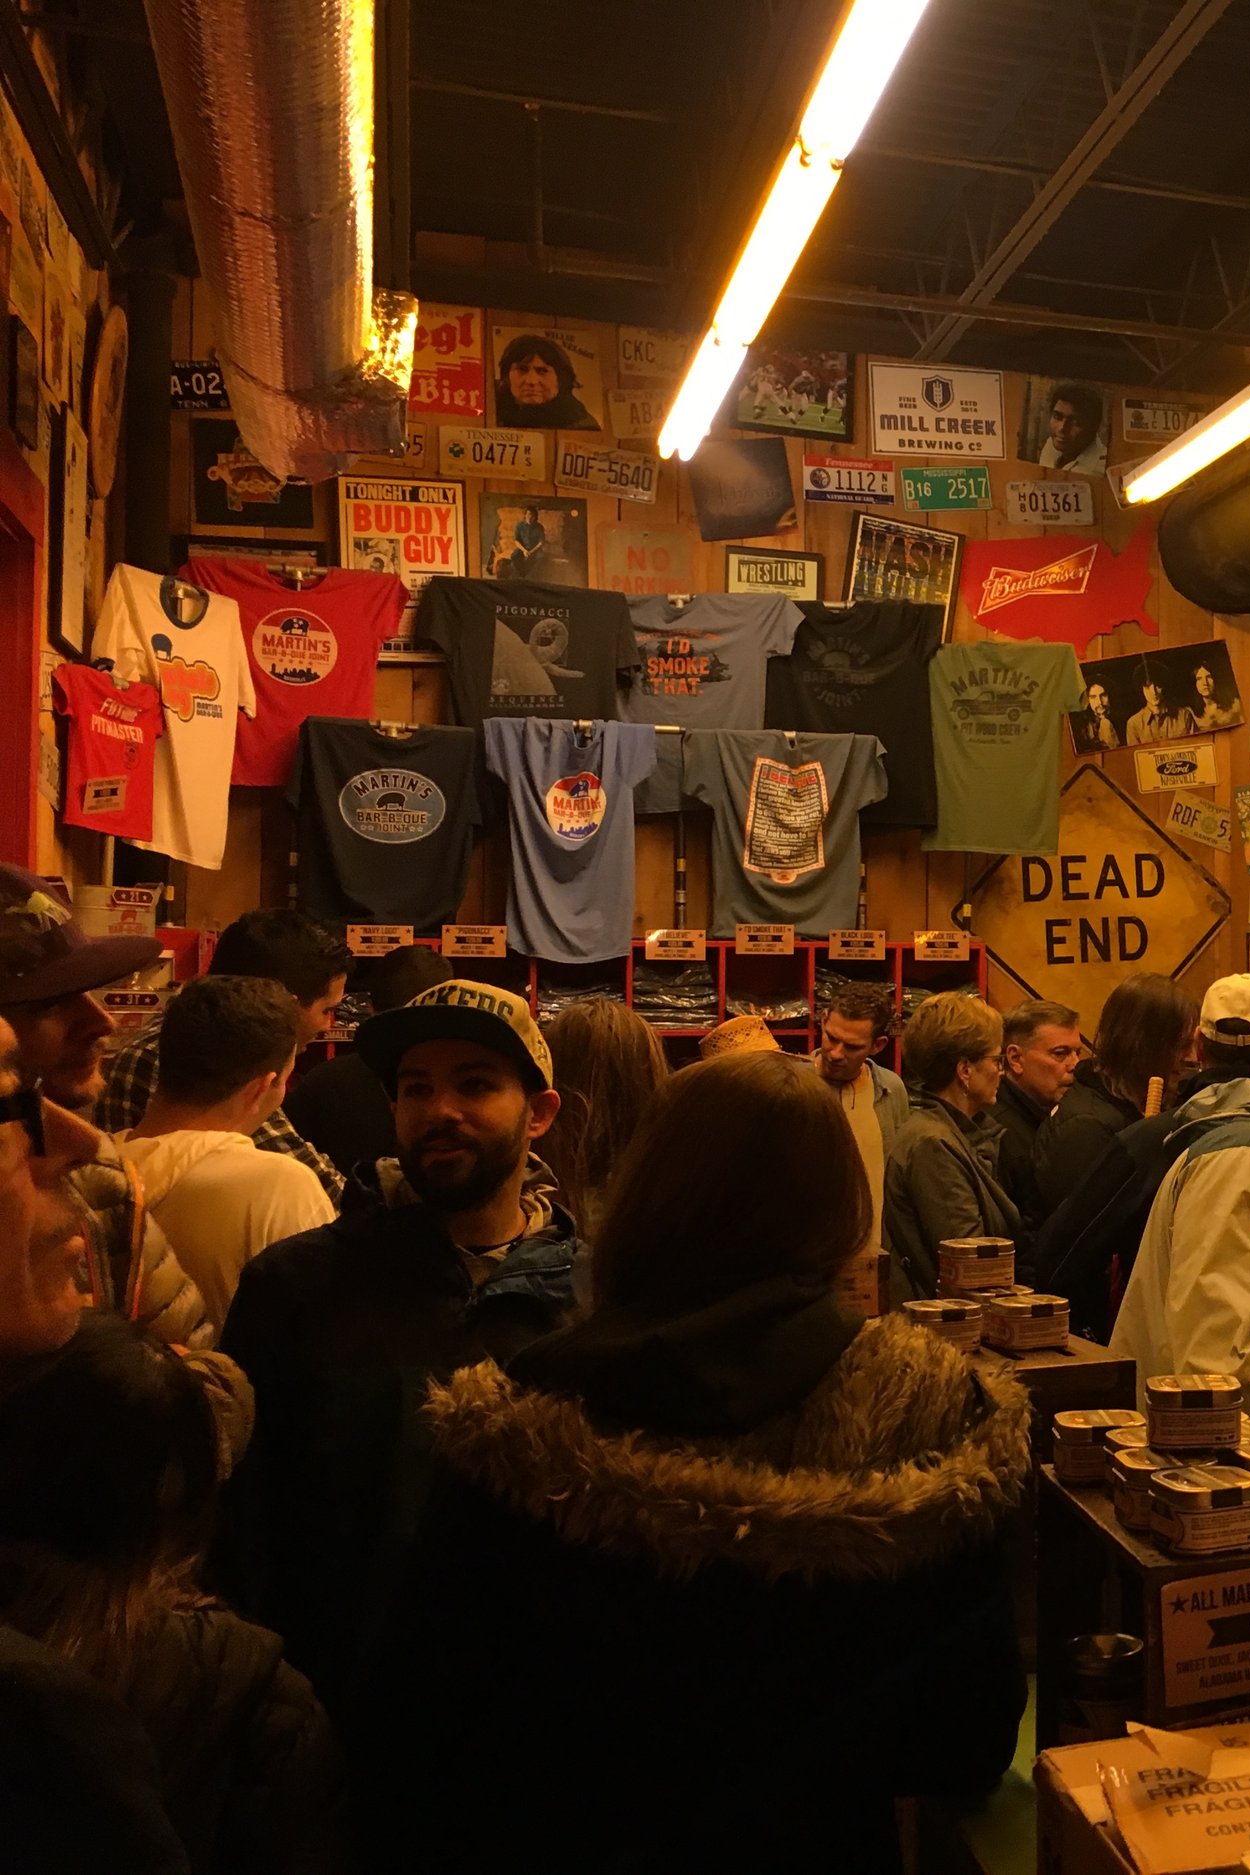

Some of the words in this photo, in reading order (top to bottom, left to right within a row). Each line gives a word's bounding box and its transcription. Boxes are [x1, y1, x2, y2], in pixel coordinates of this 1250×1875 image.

[417, 379, 481, 407] Bier
[880, 414, 930, 432] MILL
[935, 417, 997, 436] CREEK
[467, 430, 523, 442] TENNESSEE
[898, 438, 964, 451] BREWING
[472, 442, 519, 466] 0477
[824, 458, 875, 469] Tennessee
[835, 469, 876, 492] 1112
[948, 478, 987, 499] 2517
[347, 482, 411, 502] TONIGHT
[419, 486, 456, 504] ONLY
[1029, 492, 1082, 513] 01361
[353, 503, 451, 536] BUDDY
[403, 535, 453, 566] GUY
[627, 545, 671, 572] NO
[739, 562, 804, 583] WRESTLING
[990, 562, 1091, 600] Budweiser
[496, 605, 570, 617] PIGONACCI
[262, 633, 330, 653] MARTIN'S
[667, 638, 690, 654] I'D
[647, 656, 709, 675] SMOKE
[950, 668, 1039, 697] MARTIN'S
[92, 714, 143, 744] PITMASTER
[1164, 762, 1190, 774] Ford
[353, 774, 433, 799] MARTIN'S
[1160, 772, 1196, 787] NASHVILLE
[357, 811, 427, 823] BAR-B-QUE
[1172, 802, 1201, 828] RDF
[380, 824, 406, 832] JOINT
[1022, 853, 1165, 902] DEAD
[1045, 916, 1148, 965] END
[1191, 1592, 1217, 1612] ALL
[1176, 1657, 1206, 1674] SWEET
[1199, 1673, 1242, 1689] ALABAMA
